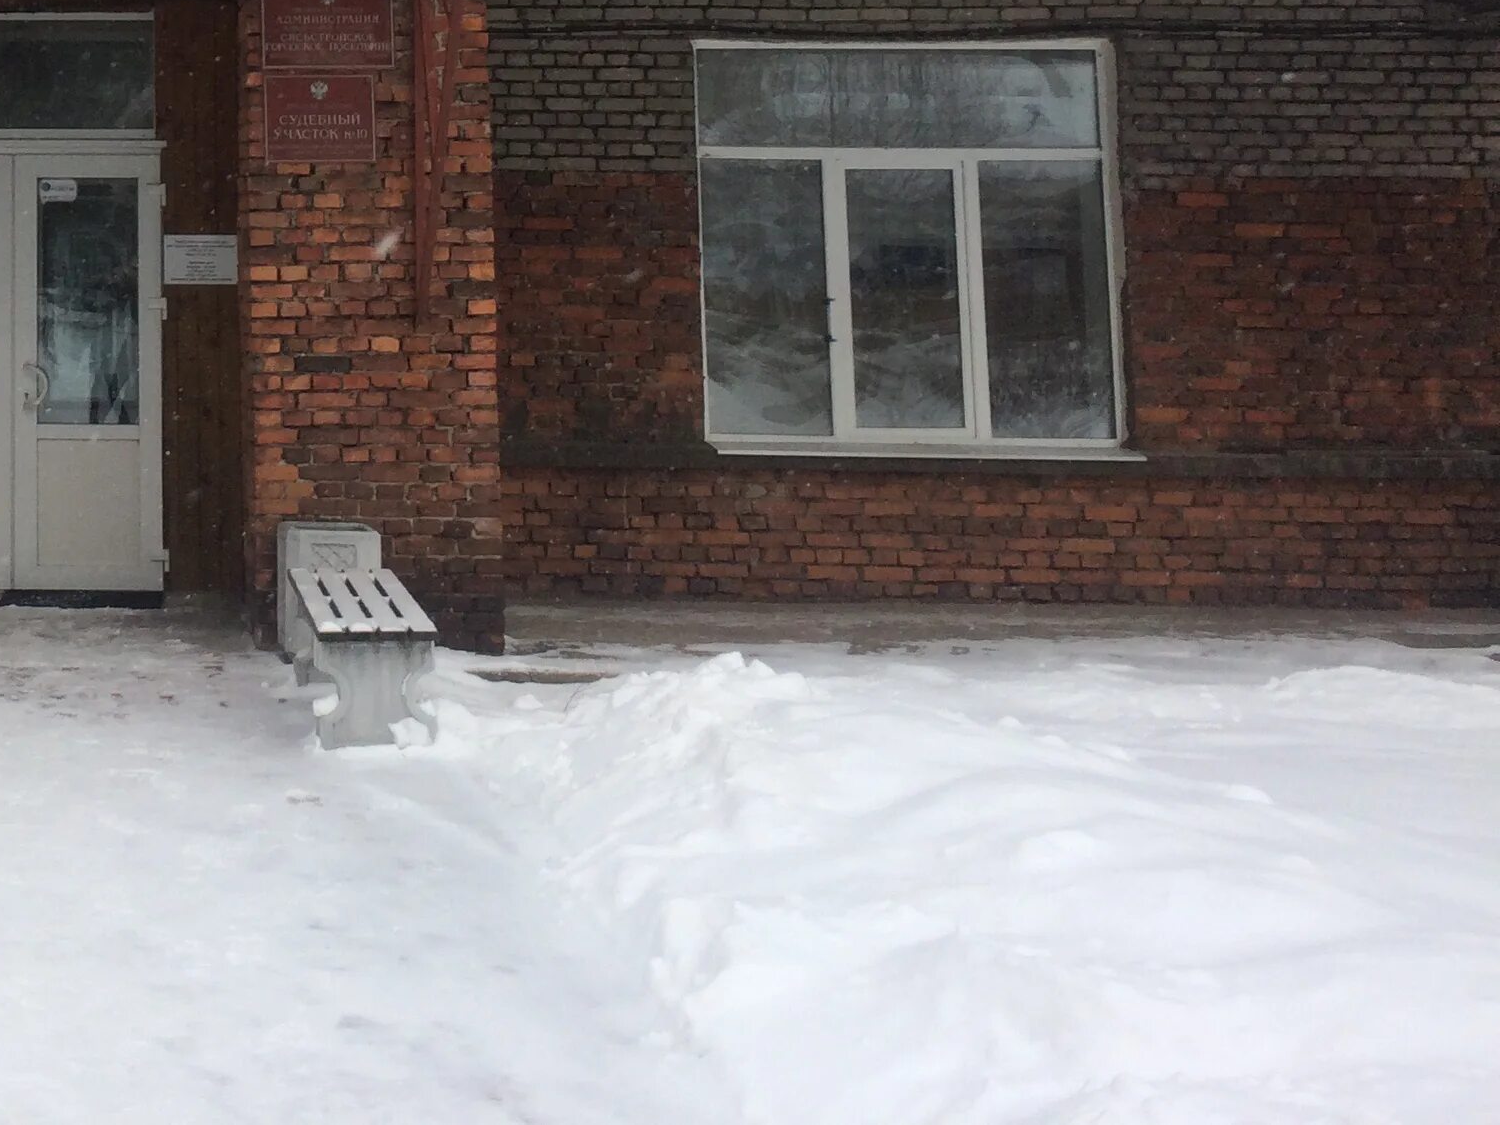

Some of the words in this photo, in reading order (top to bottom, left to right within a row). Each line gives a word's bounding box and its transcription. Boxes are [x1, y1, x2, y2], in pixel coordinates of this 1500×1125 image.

[276, 14, 380, 25] АДМИНИСТРАЦИЯ
[279, 113, 361, 127] СУДЕБНЫЙ
[273, 128, 339, 139] УЧАСТОК
